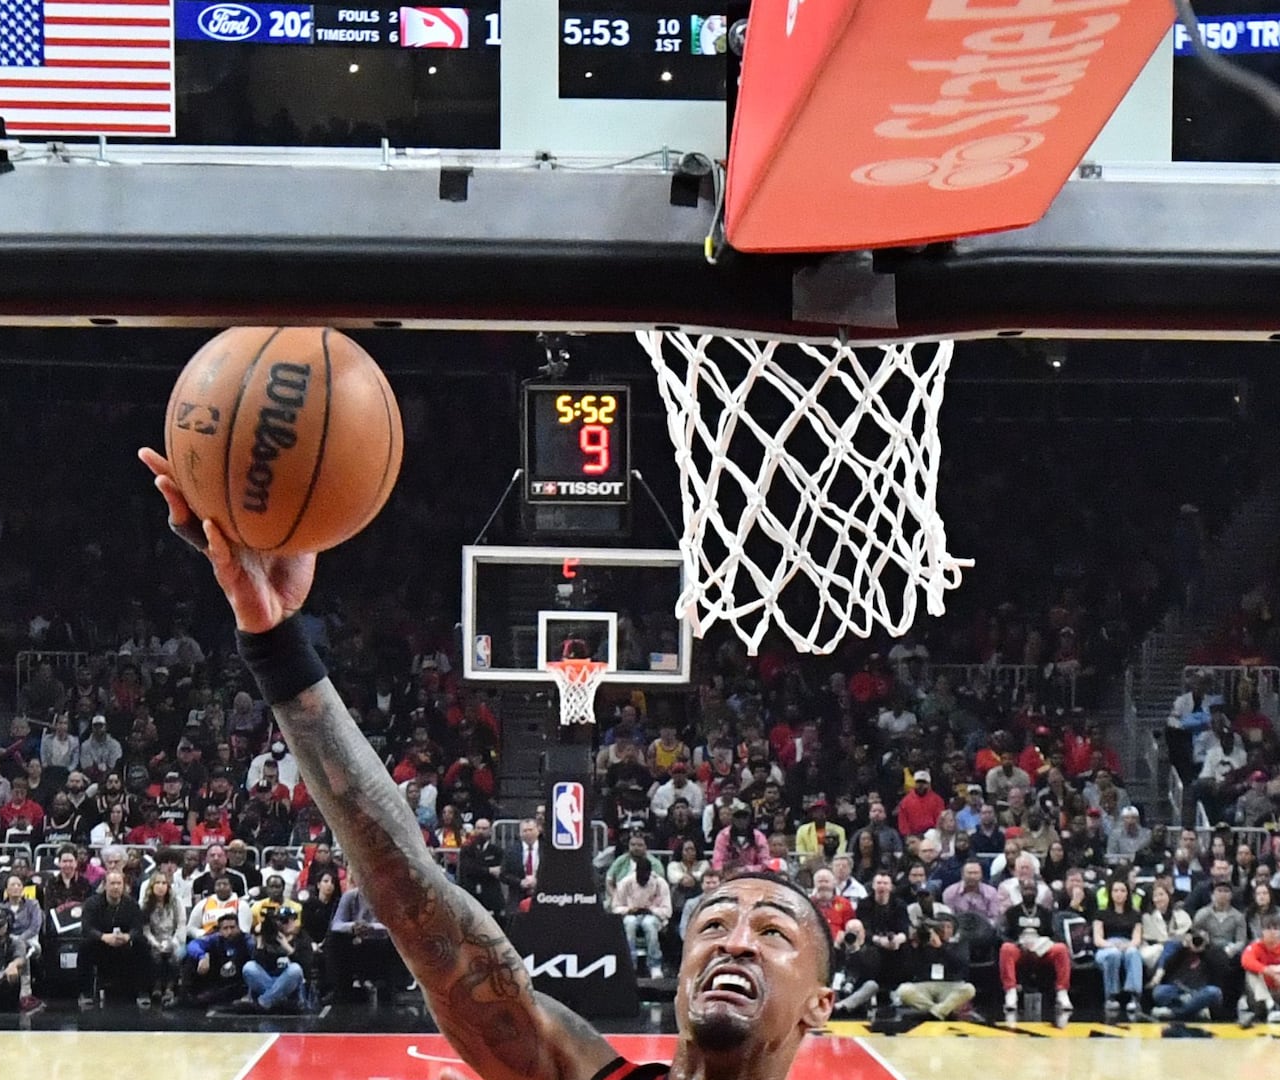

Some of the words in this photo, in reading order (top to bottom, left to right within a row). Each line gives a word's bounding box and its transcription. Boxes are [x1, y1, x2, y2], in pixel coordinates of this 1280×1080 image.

[337, 9, 380, 24] FOULS
[388, 10, 399, 24] 2
[562, 17, 631, 47] 5:53
[656, 18, 681, 36] 10
[315, 29, 380, 44] TIMEOUTS
[388, 30, 399, 45] 6
[654, 38, 683, 53] 1ST
[555, 395, 617, 425] 5:52
[243, 362, 312, 514] Wilson
[578, 424, 610, 475] 9
[557, 481, 625, 496] TISSOT
[536, 892, 573, 907] Google
[573, 892, 598, 905] Pixel
[522, 953, 618, 979] KIA
